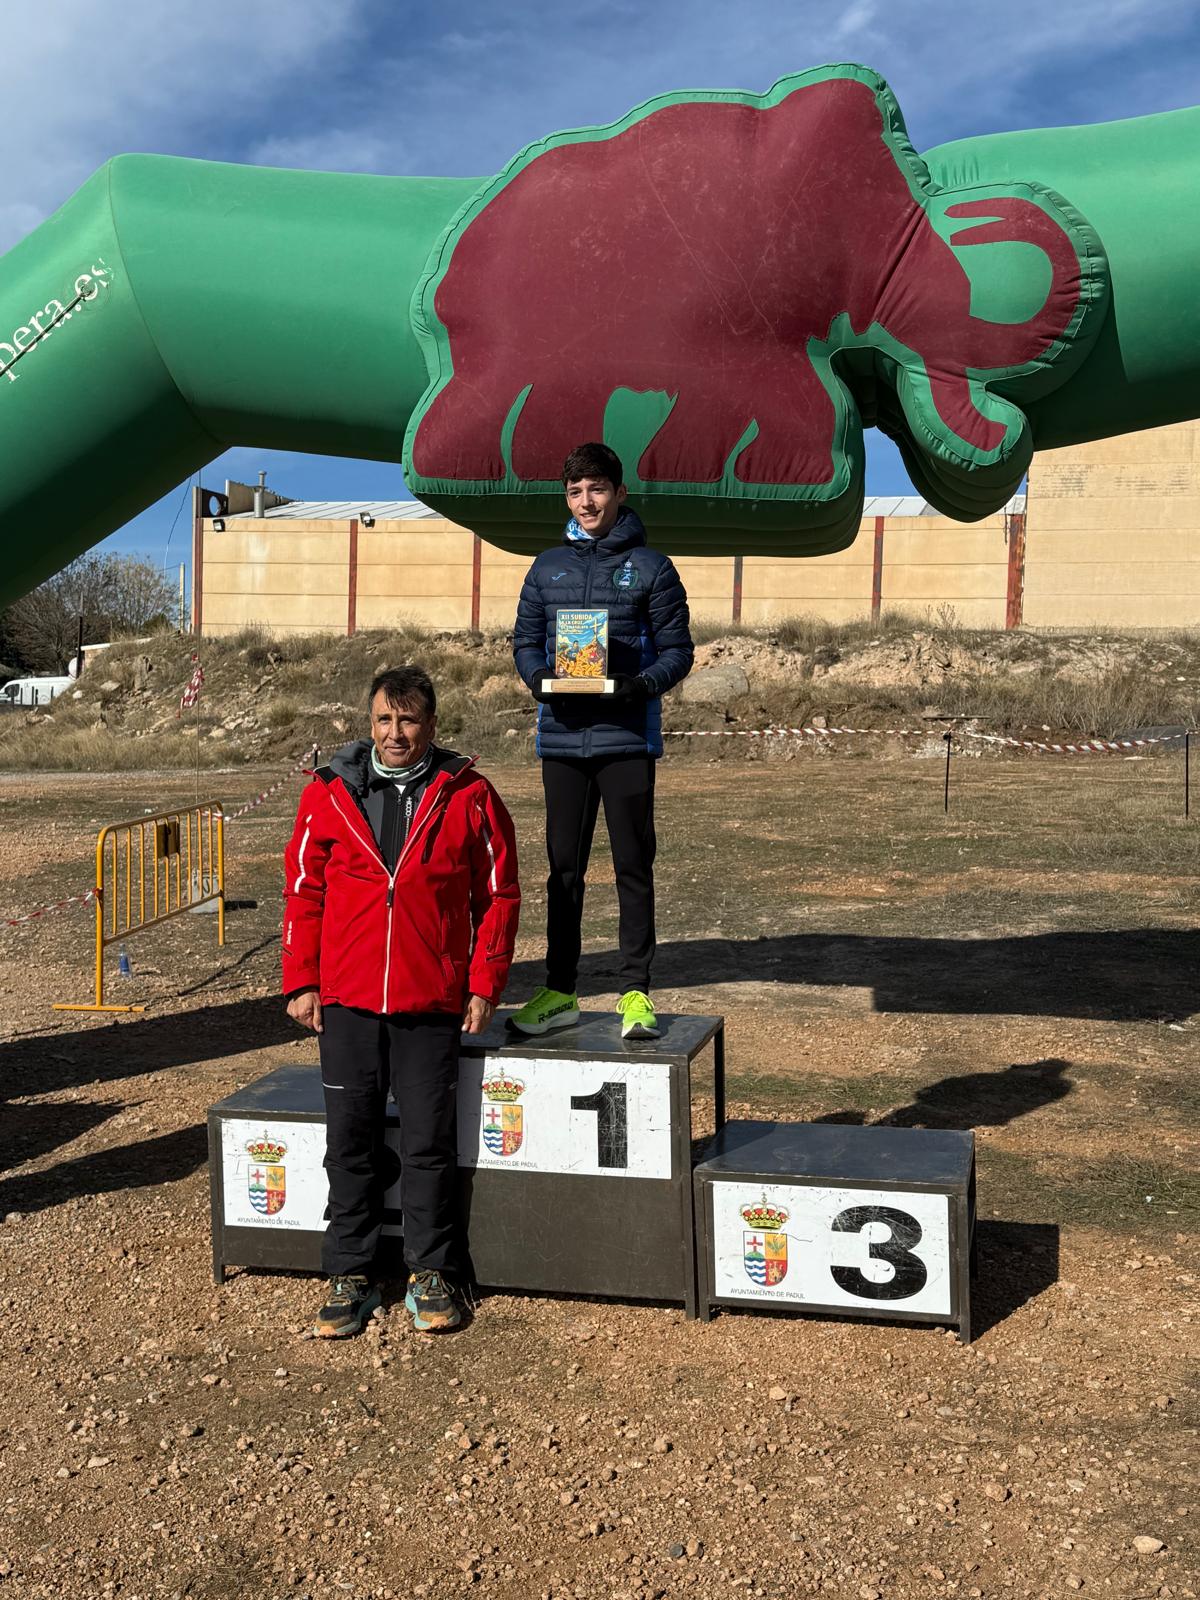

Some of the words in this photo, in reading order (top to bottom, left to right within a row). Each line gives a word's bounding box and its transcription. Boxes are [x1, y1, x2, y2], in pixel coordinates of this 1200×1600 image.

[570, 1081, 628, 1169] 1
[470, 1159, 512, 1167] AYUNTAMIENTO
[237, 1217, 275, 1225] AYUNTAMIENTO
[830, 1204, 928, 1300] 3
[730, 1287, 775, 1297] AYUNTAMIENTO
[785, 1291, 806, 1299] PADUL
